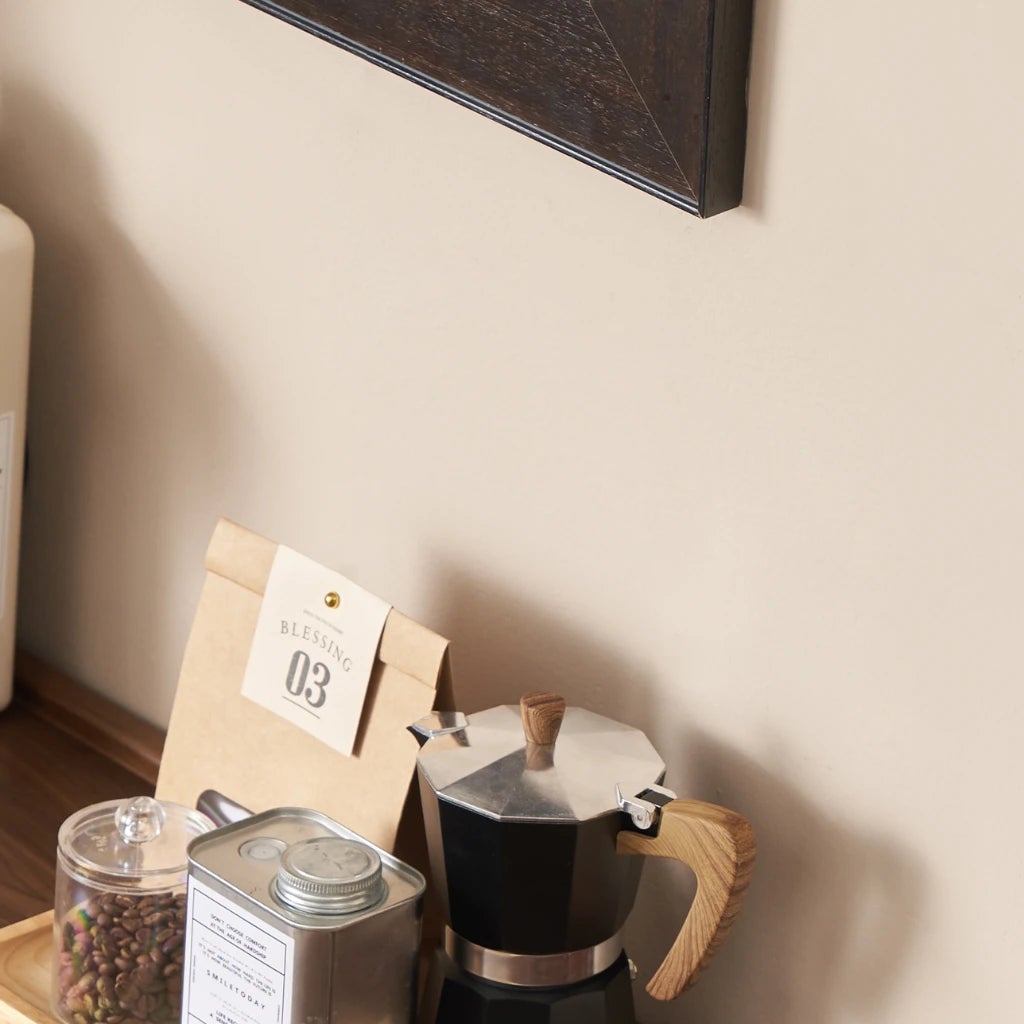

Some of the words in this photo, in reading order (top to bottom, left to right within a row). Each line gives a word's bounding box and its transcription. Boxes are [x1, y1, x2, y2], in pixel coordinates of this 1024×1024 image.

[280, 619, 353, 673] BLESSING
[285, 649, 331, 709] 03
[246, 935, 267, 952] COMFORT
